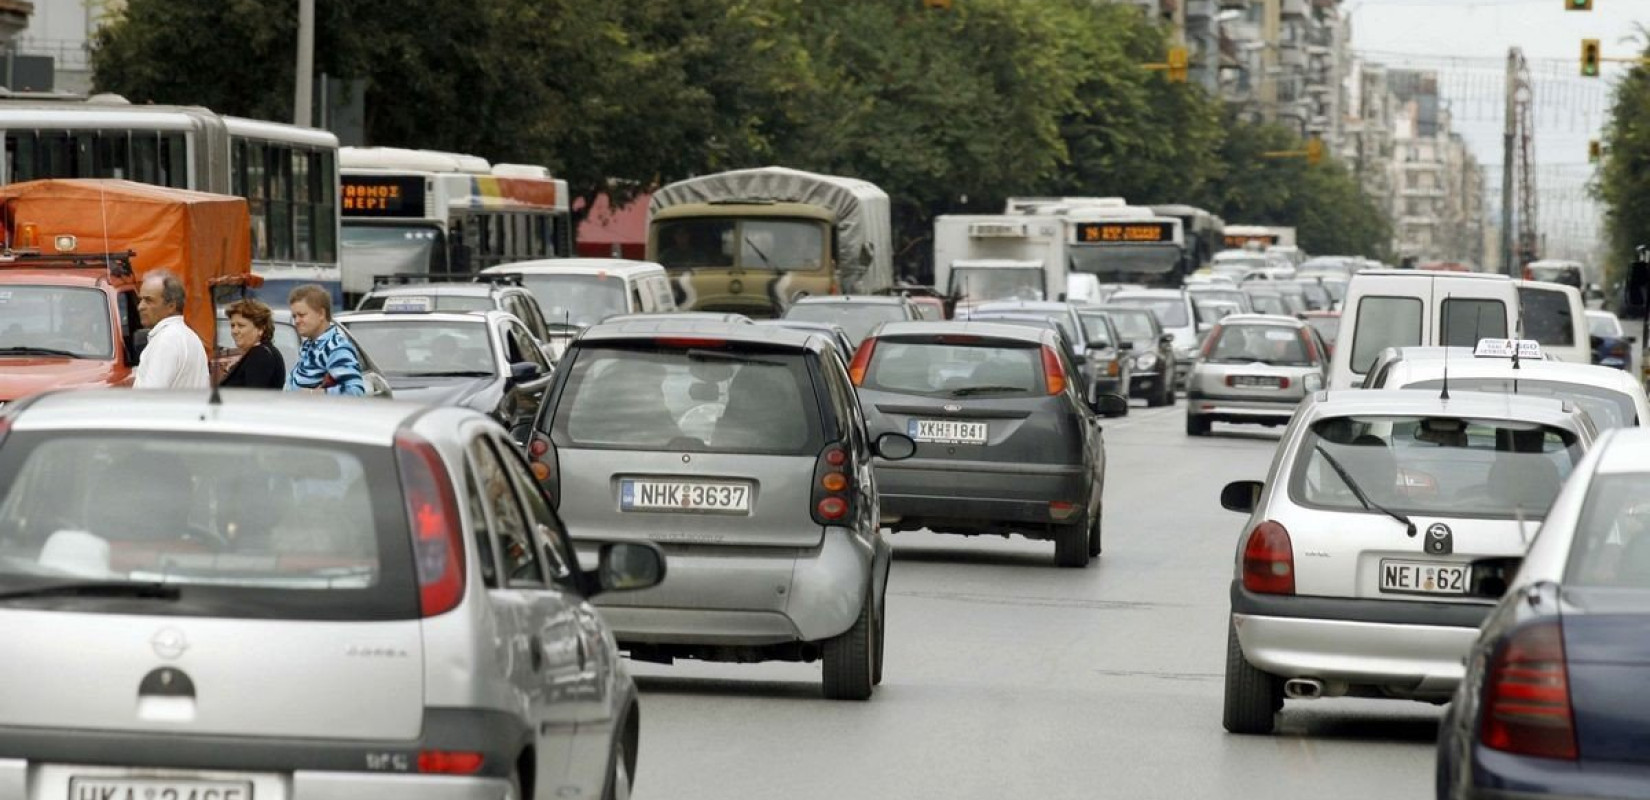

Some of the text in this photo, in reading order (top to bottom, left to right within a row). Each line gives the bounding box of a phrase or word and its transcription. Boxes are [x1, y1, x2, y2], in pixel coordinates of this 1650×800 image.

[920, 422, 944, 437] XKH
[953, 423, 983, 438] 1841
[641, 484, 745, 507] NHK 3637
[1386, 566, 1462, 590] NEI 62
